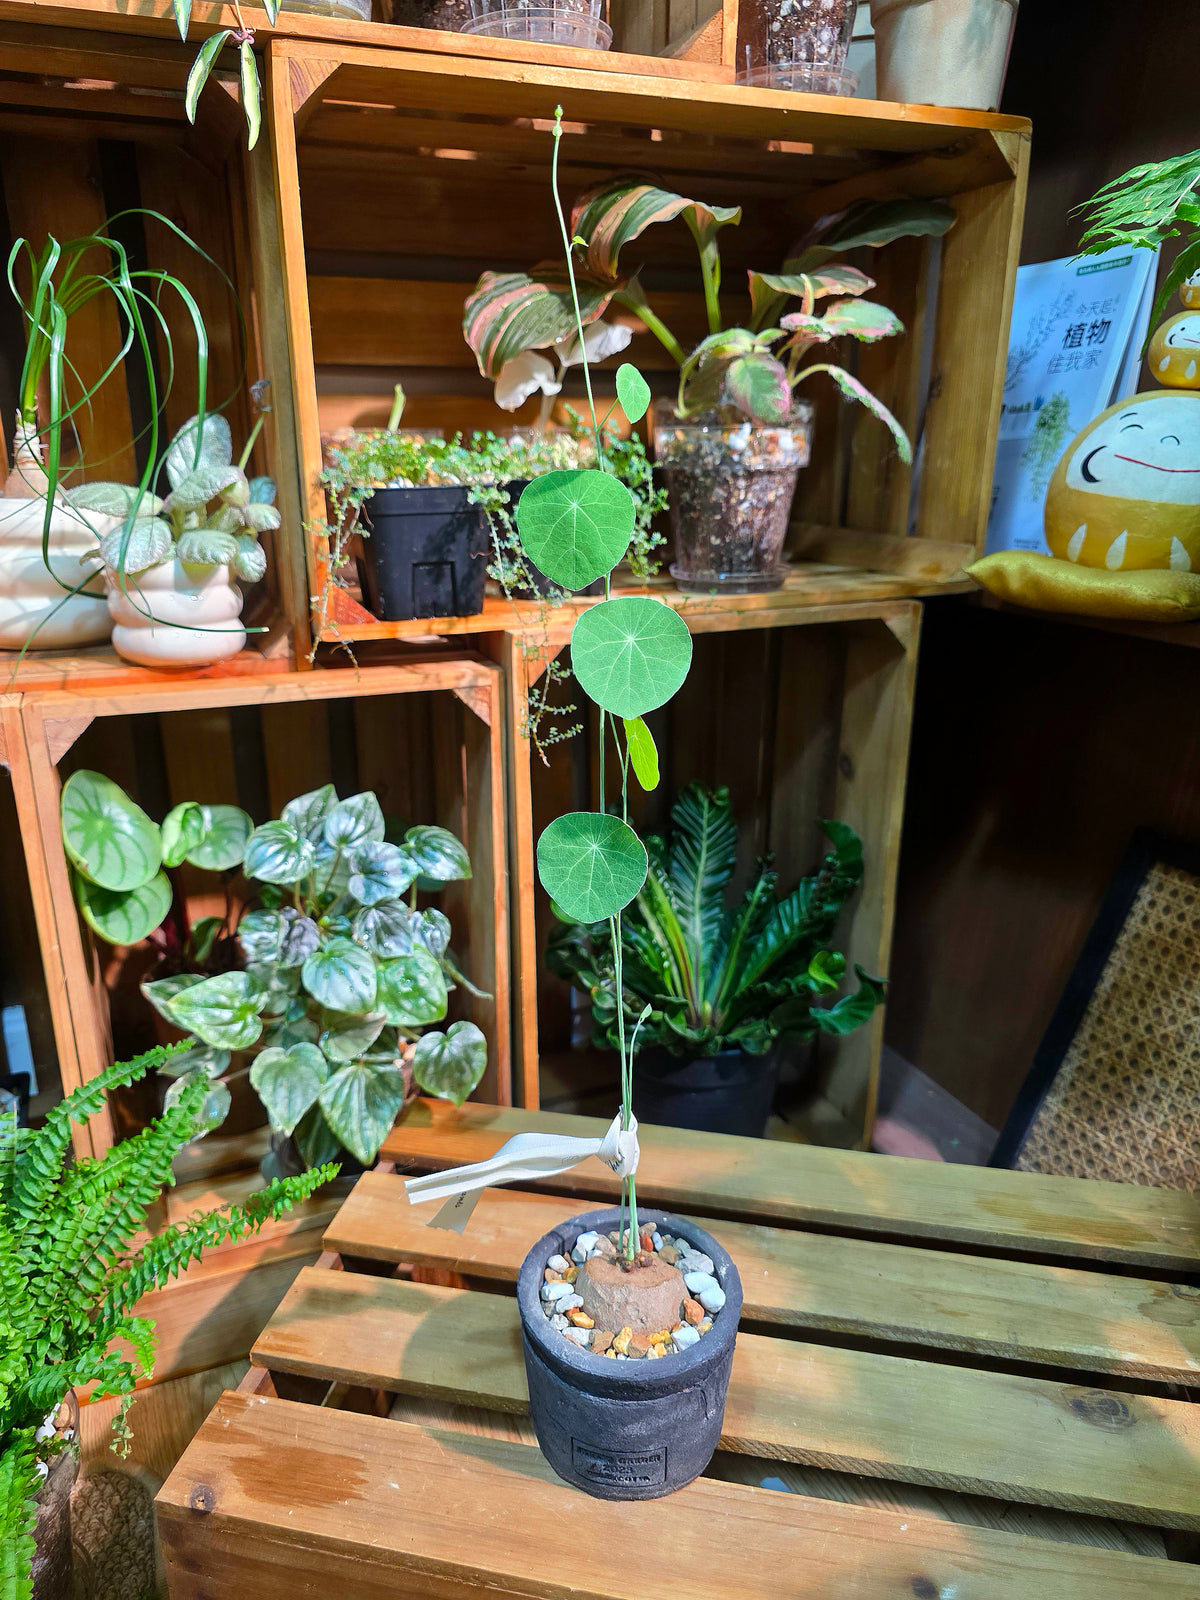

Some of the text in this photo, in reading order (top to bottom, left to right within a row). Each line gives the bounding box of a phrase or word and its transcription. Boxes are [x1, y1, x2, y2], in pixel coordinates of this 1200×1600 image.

[1062, 318, 1112, 350] 植物
[1047, 349, 1103, 375] 住我家
